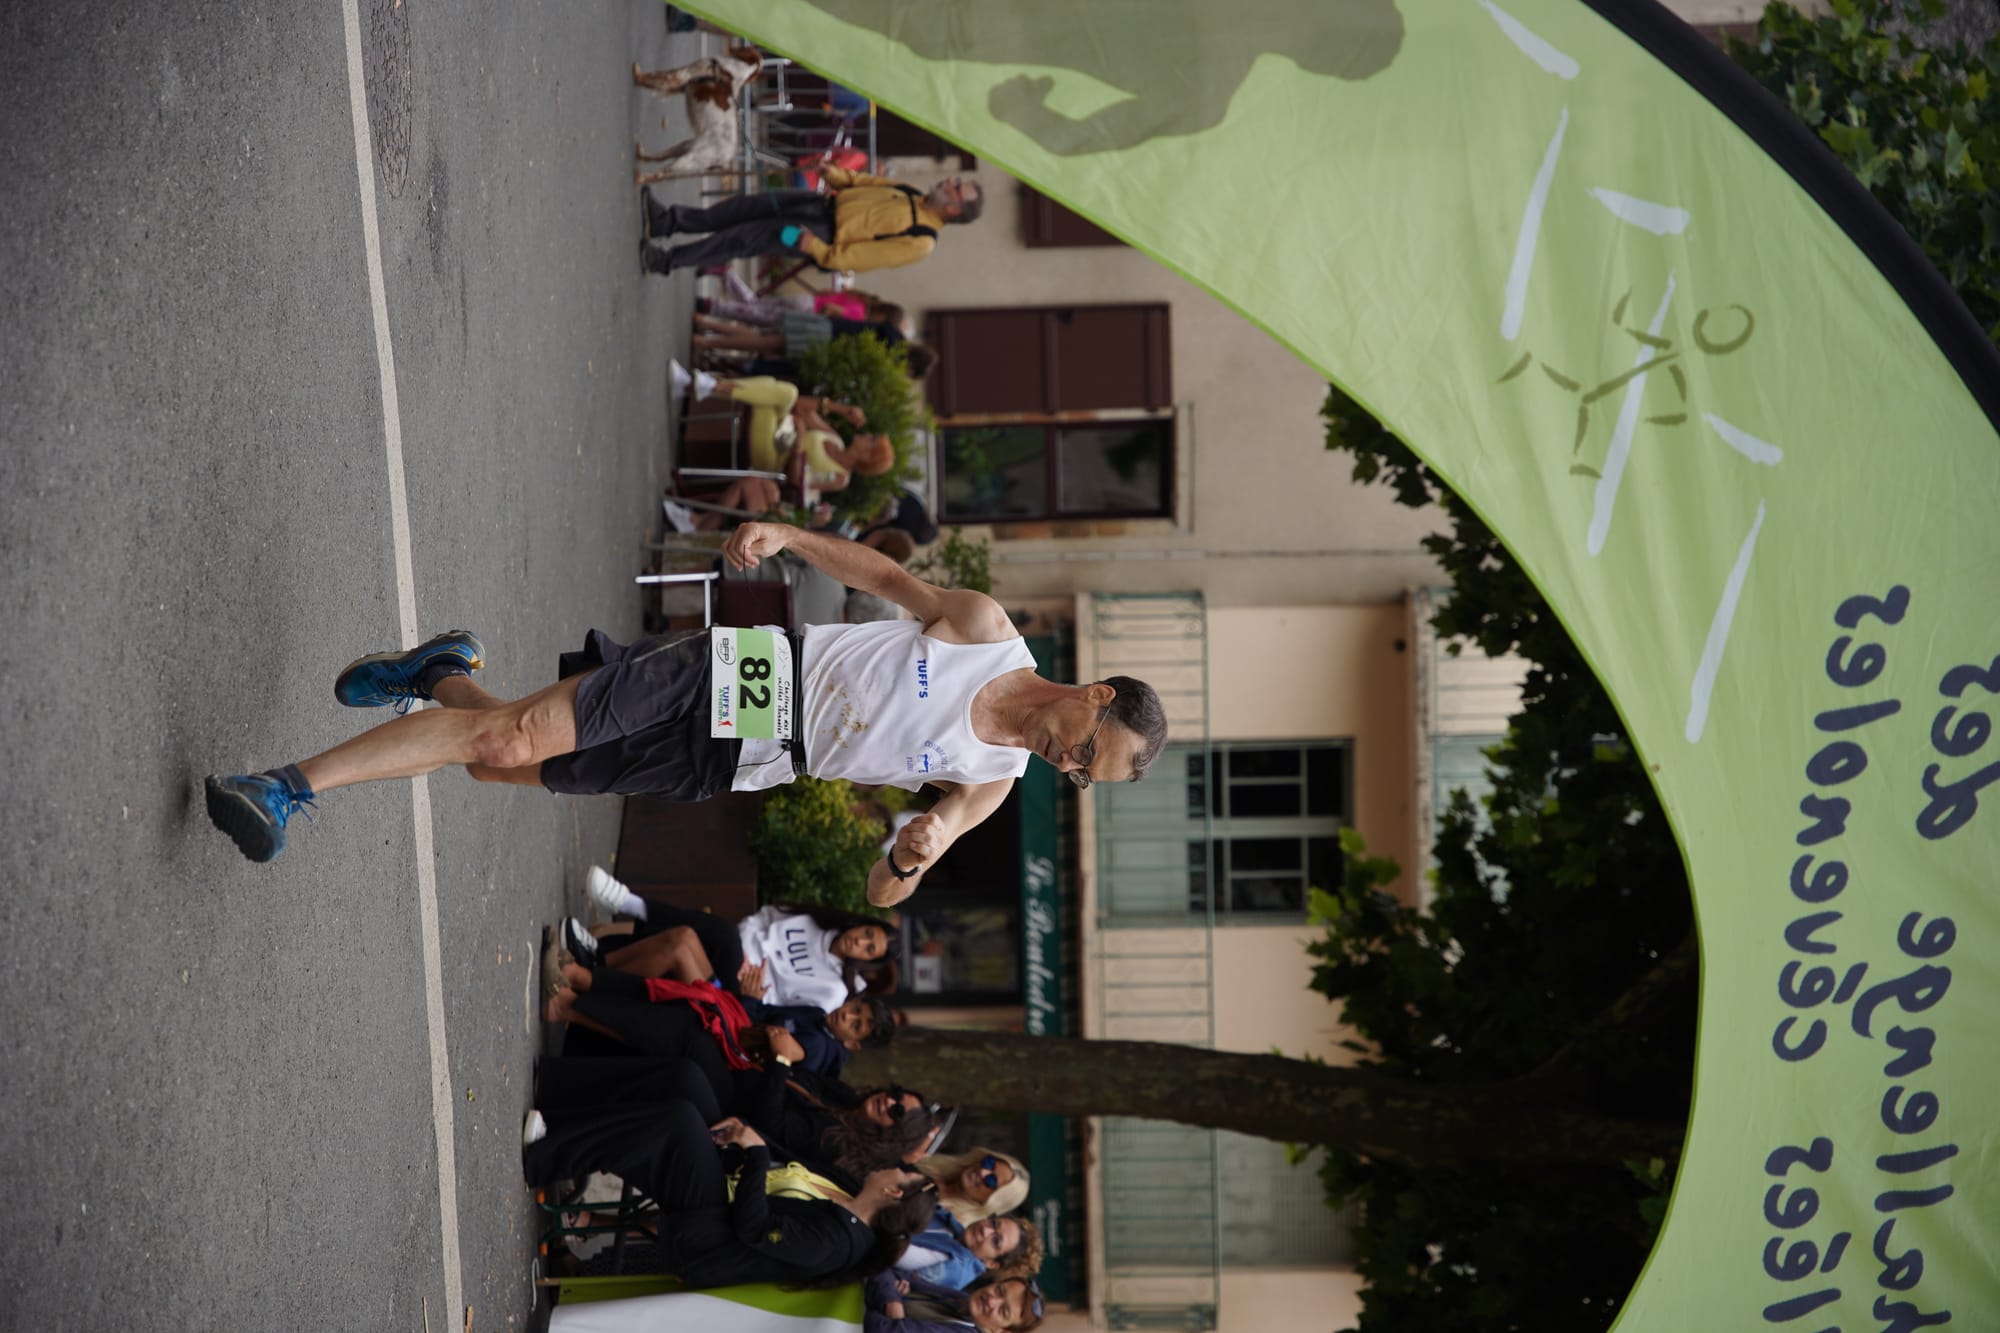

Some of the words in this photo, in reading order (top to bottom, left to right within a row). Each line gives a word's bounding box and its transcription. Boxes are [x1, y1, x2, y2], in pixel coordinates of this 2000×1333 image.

[739, 657, 772, 710] 82
[782, 681, 790, 715] Challenge
[917, 659, 928, 698] TUFF'S
[722, 685, 730, 718] TUFF'S
[1024, 853, 1055, 892] Le
